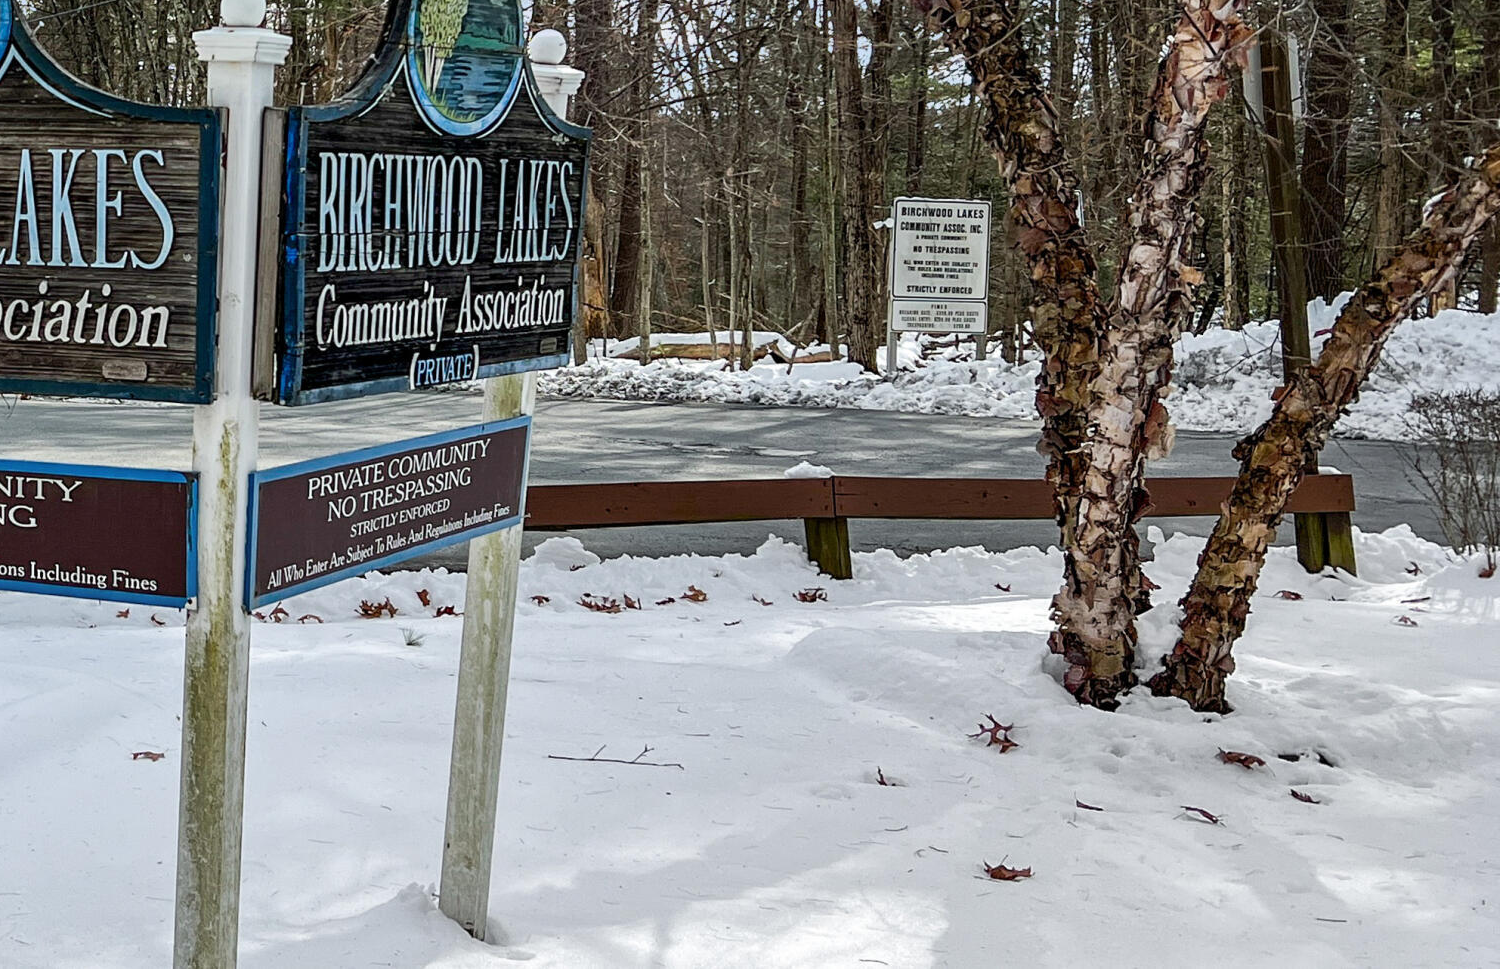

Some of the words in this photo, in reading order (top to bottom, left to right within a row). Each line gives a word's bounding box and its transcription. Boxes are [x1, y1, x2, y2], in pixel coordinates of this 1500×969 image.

[317, 152, 483, 272] BIRCHWOOD
[494, 158, 573, 264] LAKES
[901, 222, 940, 232] COMMUNITY
[943, 224, 967, 233] ASSOC.
[970, 225, 983, 233] INC.
[902, 207, 952, 217] BIRCHWOOD
[957, 209, 984, 219] LAKES
[926, 246, 970, 254] TRESPASSING
[907, 285, 936, 293] STRICTLY
[940, 286, 972, 294] ENFORCED
[316, 281, 448, 351] Community
[455, 275, 564, 334] Association
[308, 462, 384, 499] PRIVATE
[388, 439, 491, 476] COMMUNITY
[328, 495, 356, 521] NO
[361, 468, 471, 517] TRESPASSING
[351, 513, 399, 538] STRICTLY
[400, 499, 450, 523] ENFORCED
[268, 570, 281, 589] All
[284, 565, 304, 582] Who
[306, 560, 328, 577] Enter
[330, 552, 345, 568] Are
[347, 543, 373, 565] Subject
[375, 538, 384, 554] To
[386, 535, 406, 554] Rules
[408, 528, 423, 543] And
[425, 518, 462, 541] Regulations
[464, 508, 492, 527] Including
[493, 504, 510, 517] Fines
[30, 560, 107, 588] Including
[112, 570, 157, 591] Fines
